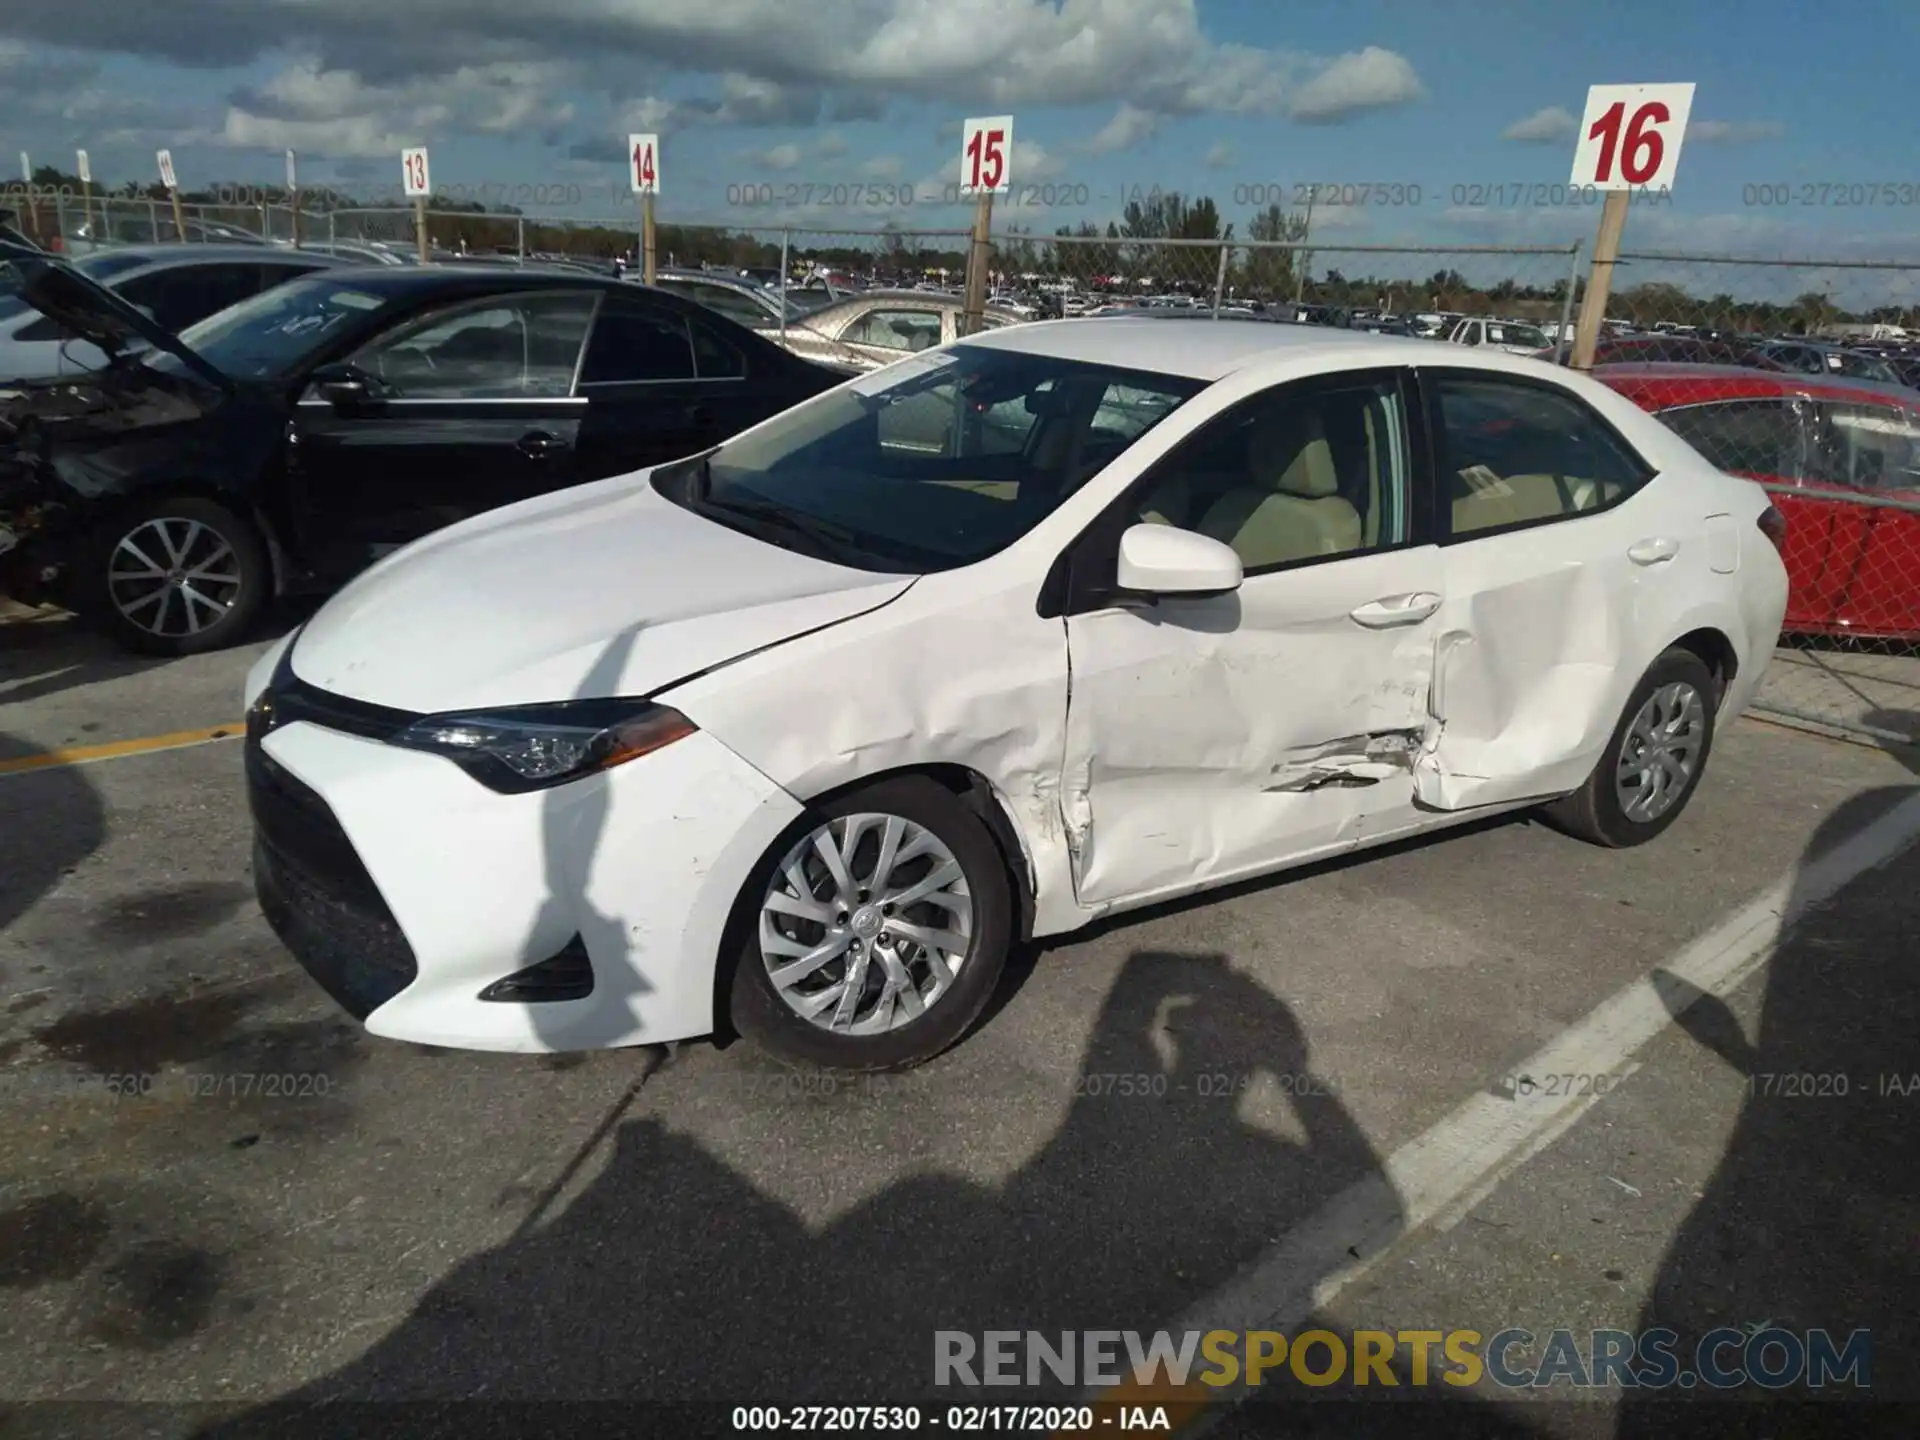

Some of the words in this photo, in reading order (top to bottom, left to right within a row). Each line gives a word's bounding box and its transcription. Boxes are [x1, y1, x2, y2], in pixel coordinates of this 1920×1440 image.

[632, 143, 655, 188] 14
[967, 129, 1004, 189] 15
[1588, 102, 1671, 185] 16
[405, 153, 425, 189] 13
